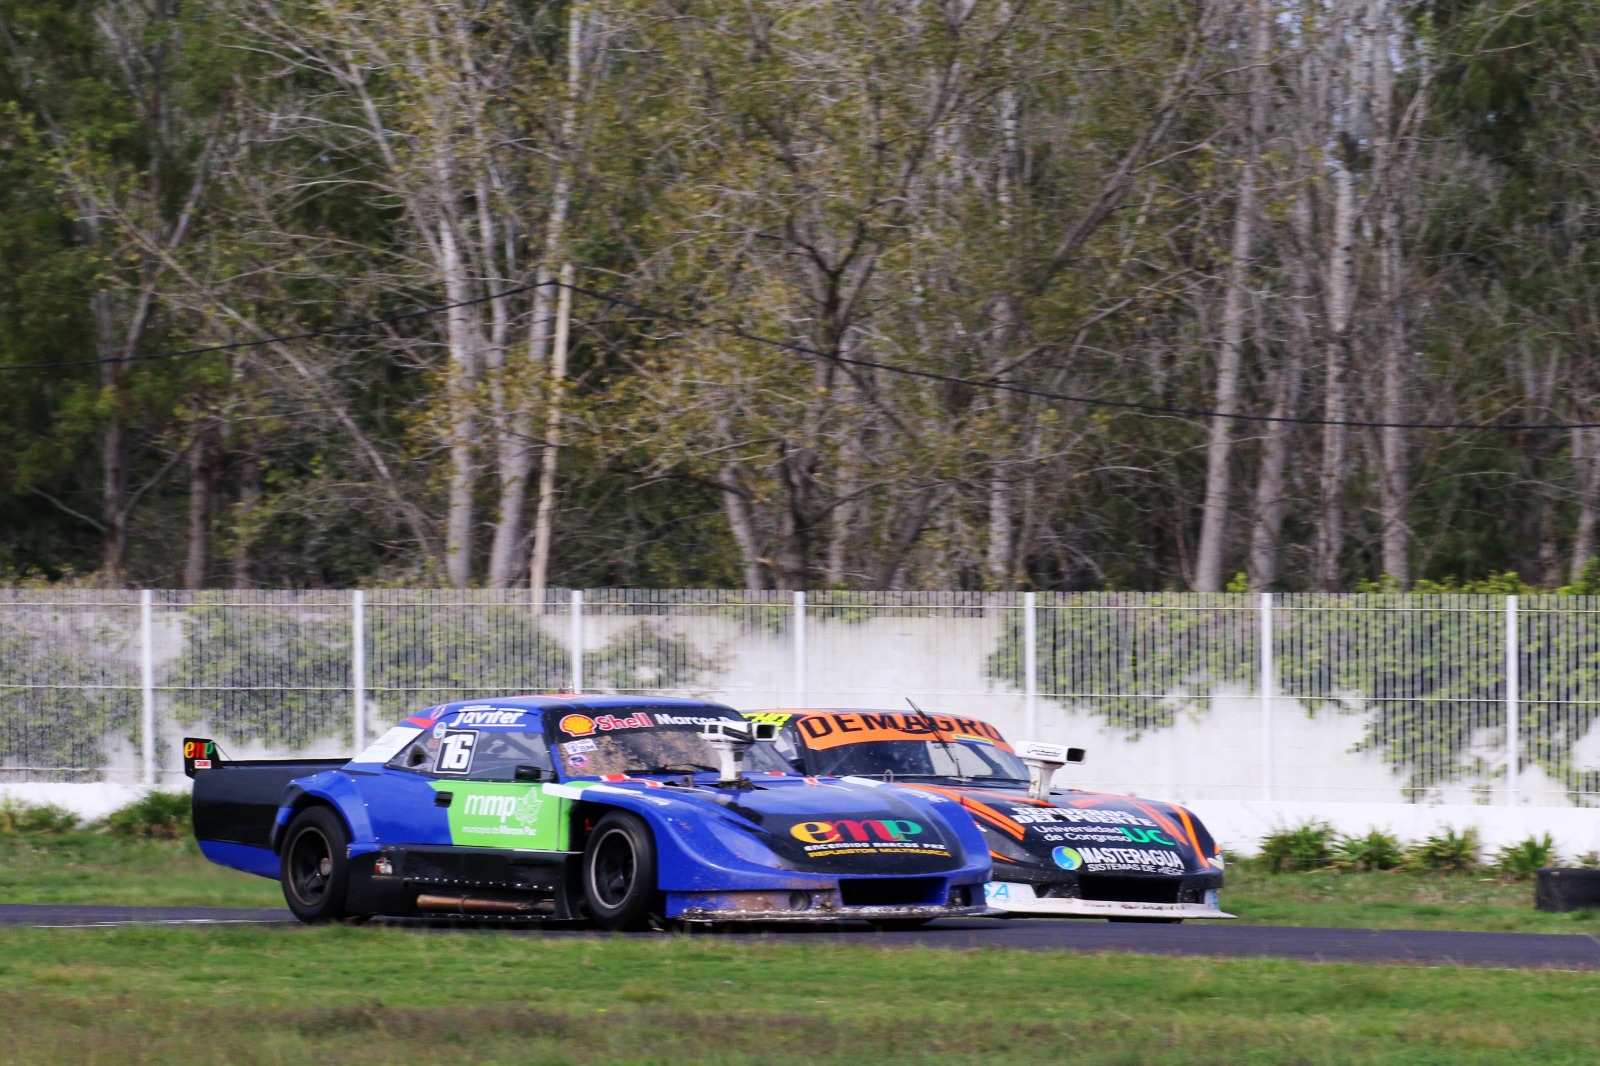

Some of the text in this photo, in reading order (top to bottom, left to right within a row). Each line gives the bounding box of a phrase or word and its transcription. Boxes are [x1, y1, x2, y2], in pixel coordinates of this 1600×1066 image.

[597, 713, 654, 730] Shell
[800, 714, 1006, 742] DEMAGRO
[441, 734, 474, 769] 16
[464, 794, 516, 823] mmp
[1009, 815, 1064, 824] DEL
[789, 819, 923, 844] emp
[1032, 825, 1175, 846] Universidad UC
[1044, 832, 1133, 843] de Congreso
[1076, 847, 1186, 870] MASTERAGUA
[1087, 863, 1141, 872] SISTEMAS
[1141, 864, 1157, 873] DE
